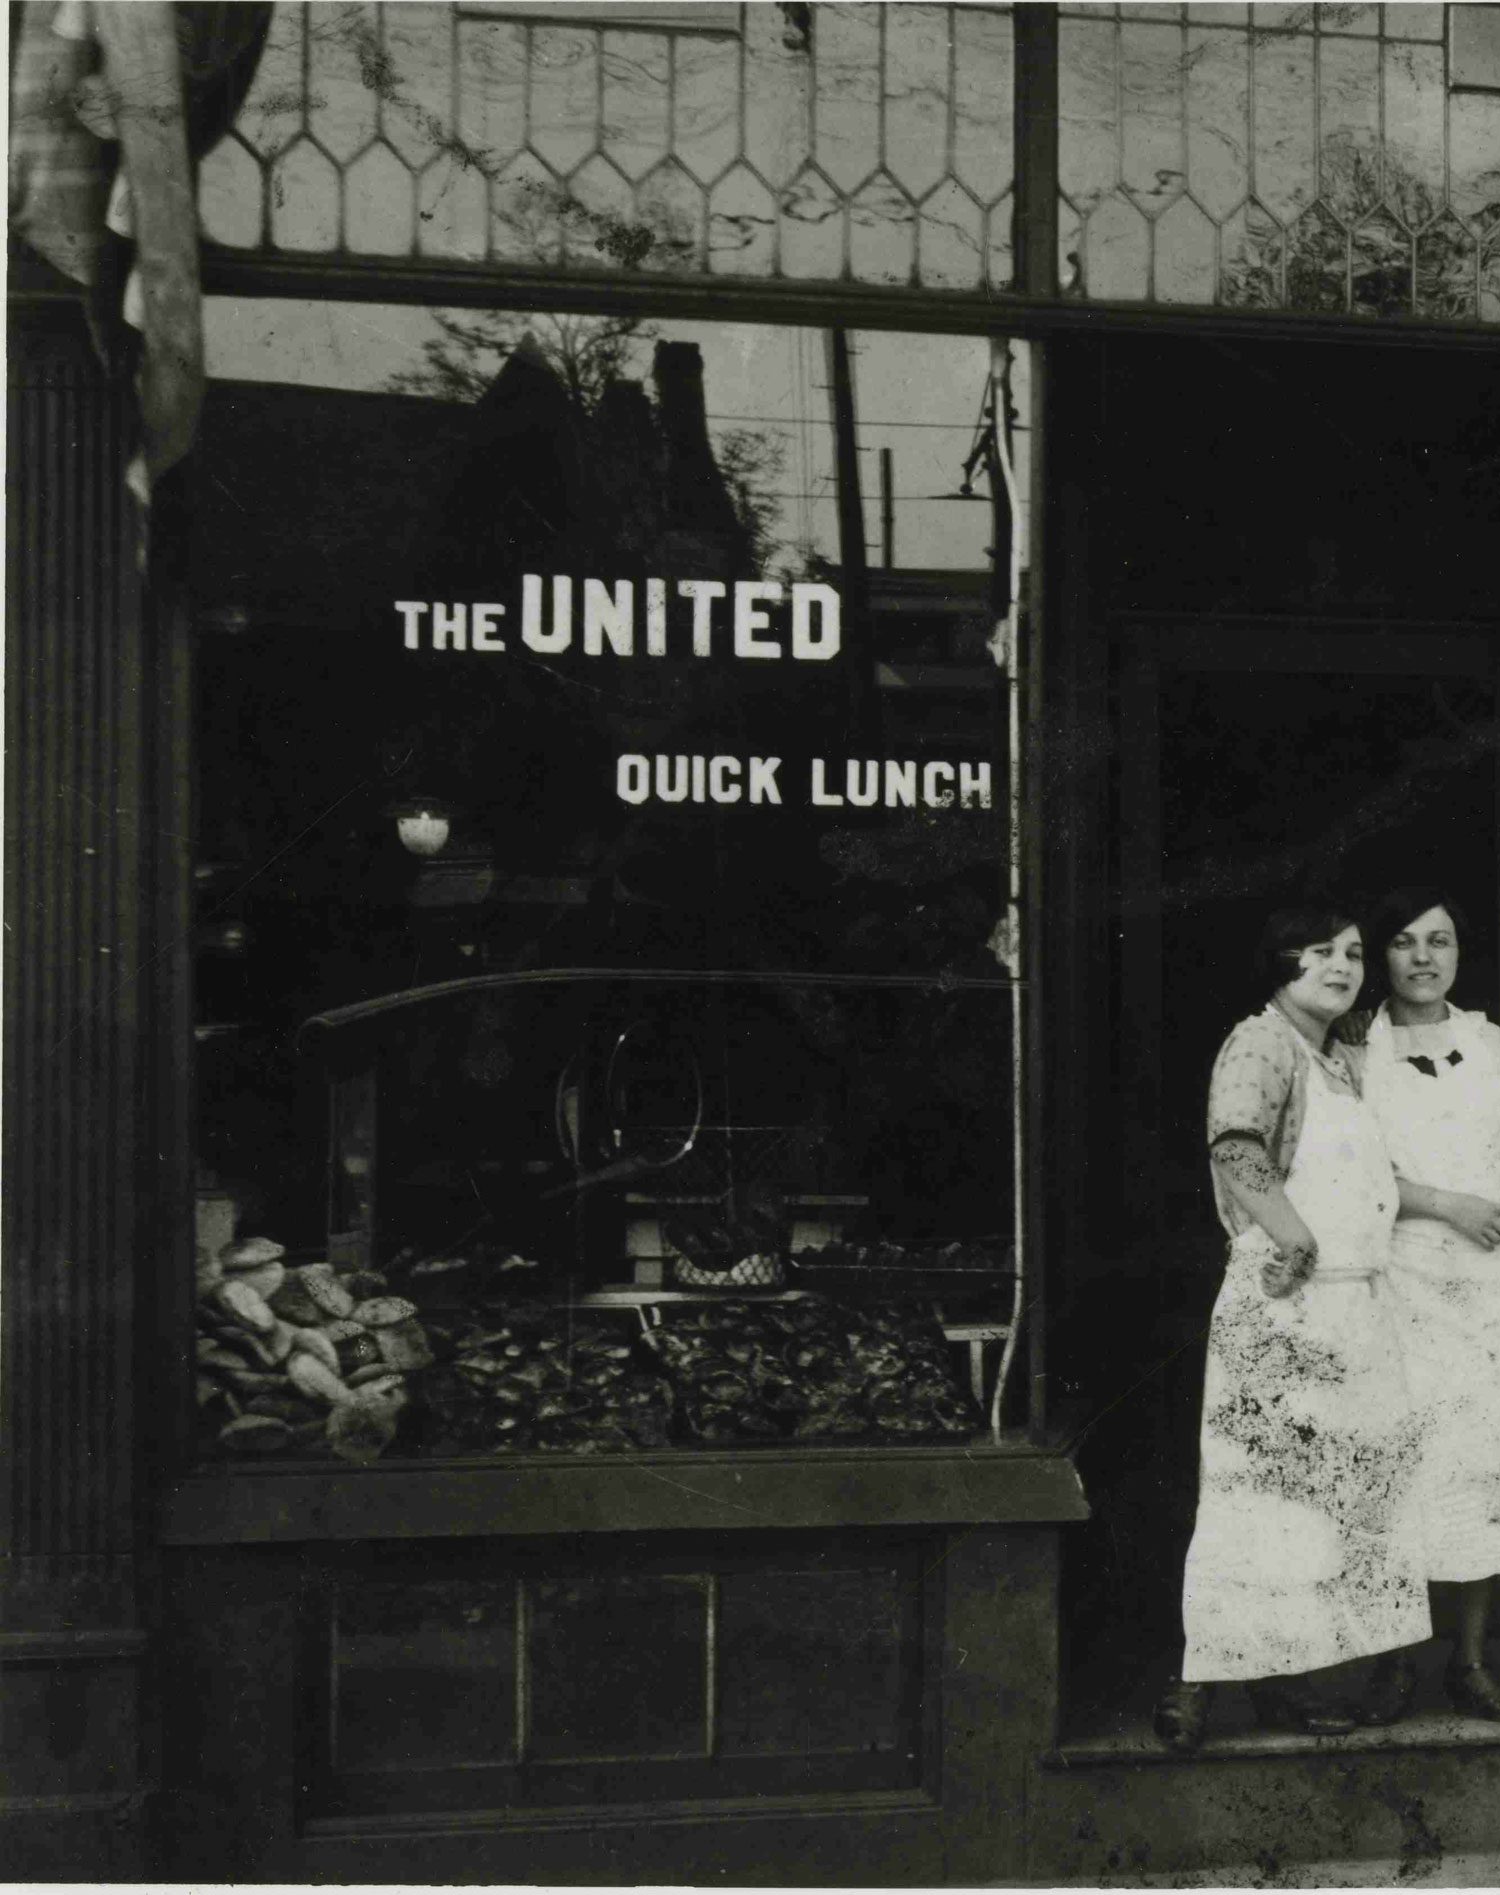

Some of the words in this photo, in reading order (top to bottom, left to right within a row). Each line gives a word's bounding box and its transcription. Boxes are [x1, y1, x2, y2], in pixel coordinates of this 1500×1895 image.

[394, 600, 507, 652] THE
[521, 574, 841, 660] UNITED
[616, 754, 783, 805] QUICK
[811, 758, 992, 809] LUNCH
